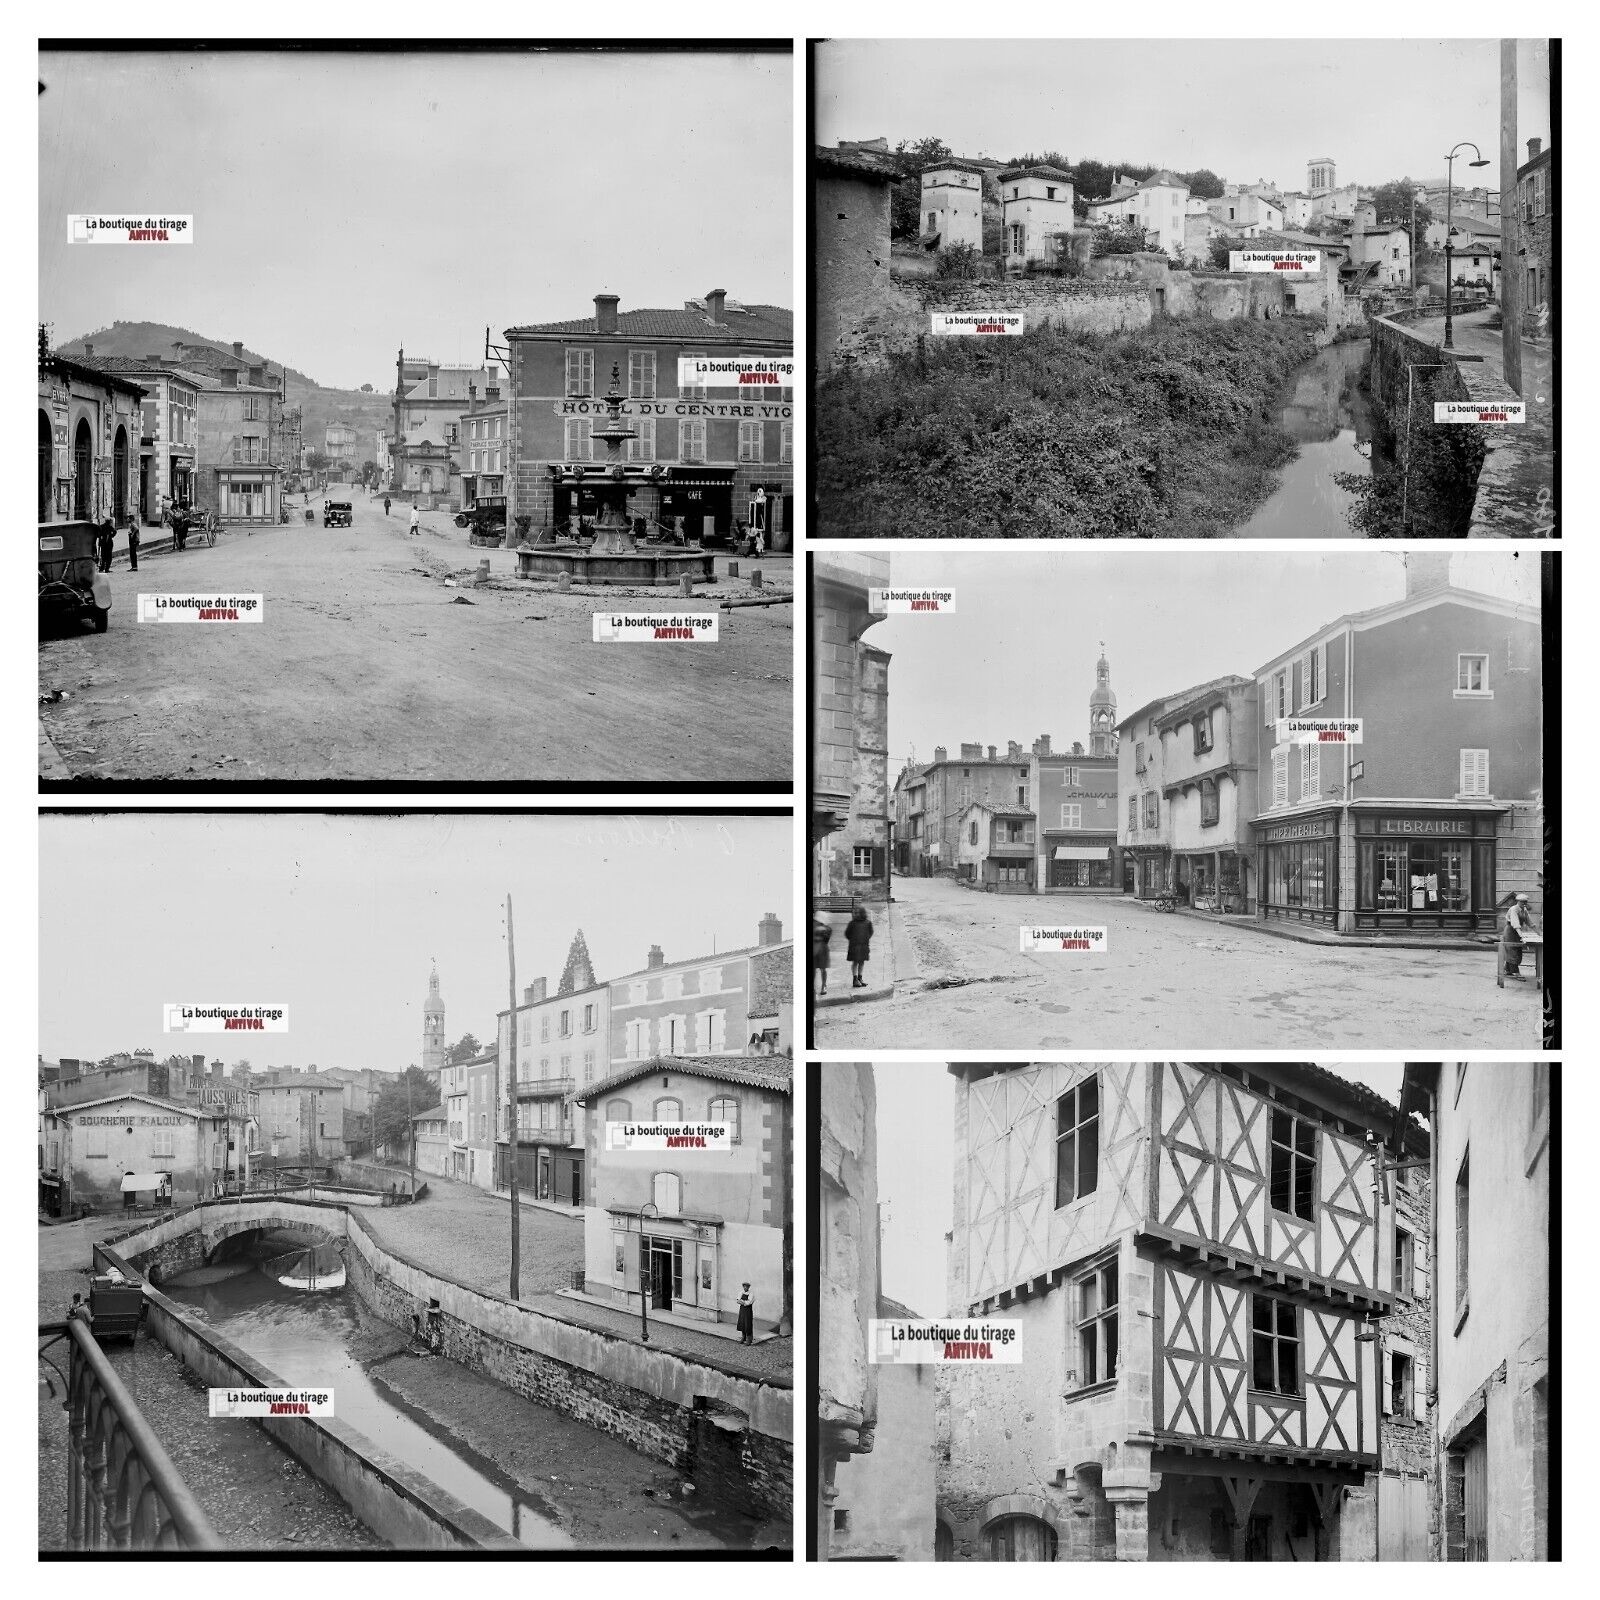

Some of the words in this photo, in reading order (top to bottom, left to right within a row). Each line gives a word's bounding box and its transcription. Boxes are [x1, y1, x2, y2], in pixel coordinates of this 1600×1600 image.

[562, 401, 632, 414] HÔTL
[640, 404, 667, 414] DU
[675, 404, 754, 417] CENTRE
[1386, 820, 1466, 833] LIBRAIRIE
[79, 1116, 135, 1126] BOUCHERIE
